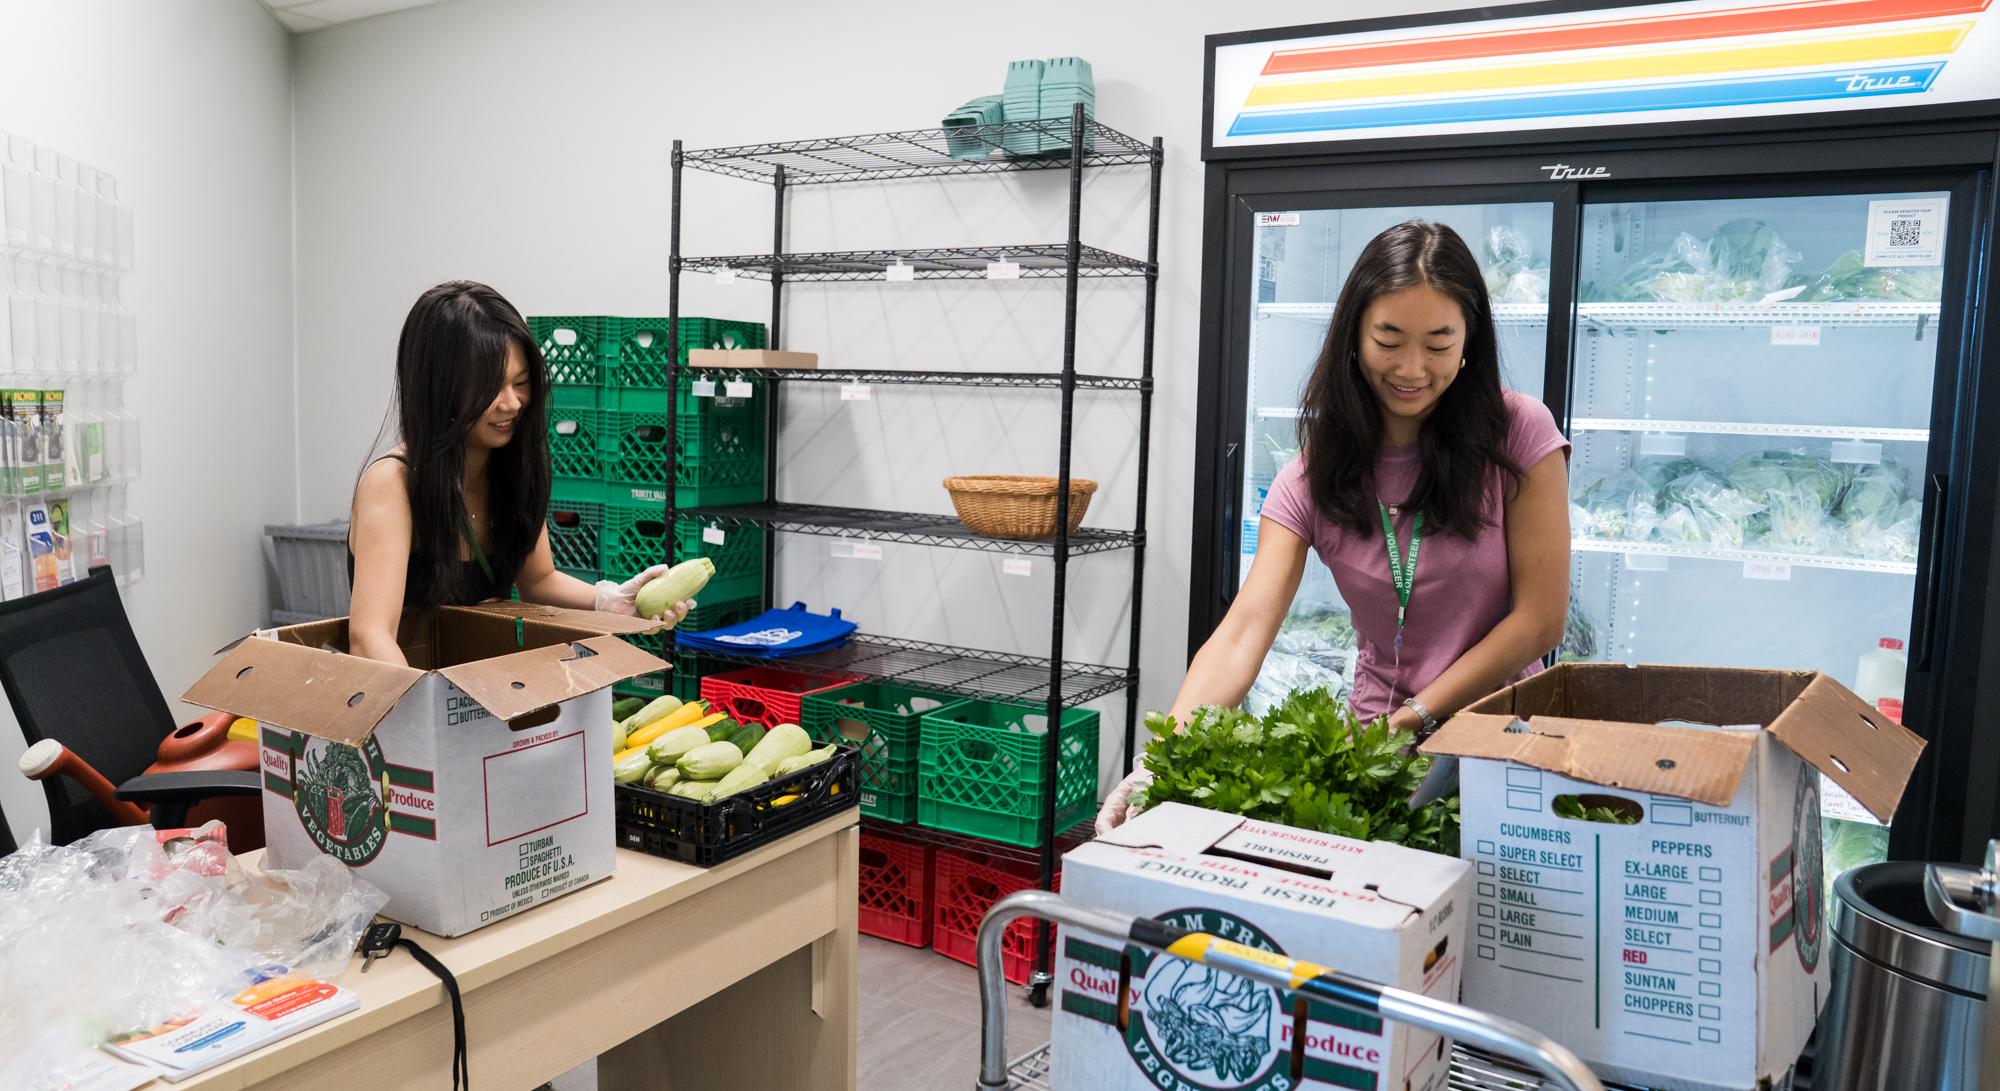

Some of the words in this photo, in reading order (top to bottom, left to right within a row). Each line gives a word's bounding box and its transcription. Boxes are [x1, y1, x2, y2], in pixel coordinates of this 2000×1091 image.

[1836, 74, 1917, 92] true
[1541, 163, 1611, 180] true
[1386, 532, 1403, 589] VOLUNTEER
[1404, 538, 1420, 594] VOLUNTEER
[512, 738, 530, 748] GROWN
[535, 732, 551, 743] PACKED
[262, 749, 289, 775] Quality
[388, 788, 435, 812] Produce
[1694, 811, 1751, 826] BUTTERNUT
[302, 805, 382, 861] VEGETABLES
[529, 835, 554, 851] TURBAN
[1500, 822, 1571, 844] CUCUMBERS
[530, 846, 562, 866] SPAGHETTI
[1243, 841, 1328, 866] PERISHABLE
[1333, 841, 1364, 854] KEEP
[1500, 844, 1536, 862] SUPER
[1540, 850, 1583, 868] SELECT
[1652, 840, 1713, 858] PEPPERS
[505, 865, 541, 890] PRODUCE
[542, 862, 552, 877] OF
[553, 854, 575, 872] U.S.A.
[1136, 860, 1248, 890] PRODUCE
[1199, 860, 1259, 878] WITH
[1500, 866, 1540, 884] SELECT
[1625, 860, 1689, 879] EX-LARGE
[512, 886, 528, 898] UNLESS
[529, 878, 552, 893] OTHERWISE
[553, 871, 570, 882] MARKED
[548, 882, 568, 895] PRODUCT
[568, 879, 574, 888] OF
[574, 873, 589, 886] CANADA
[1625, 883, 1667, 900] LARGE
[1262, 884, 1337, 909] FRESH
[1500, 887, 1537, 905] SMALL
[489, 904, 510, 918] PRODUCT
[510, 901, 516, 911] OF
[517, 896, 534, 908] MEXICO
[1625, 905, 1679, 924] MEDIUM
[1500, 908, 1536, 927] LARGE
[1500, 930, 1532, 948] PLAIN
[1625, 927, 1672, 945] SELECT
[1622, 948, 1648, 964] RED
[1070, 967, 1142, 1005] Qualy
[1625, 971, 1676, 991] SUNTAN
[1625, 993, 1694, 1016] CHOPPERS
[1280, 1023, 1381, 1064] Poduce
